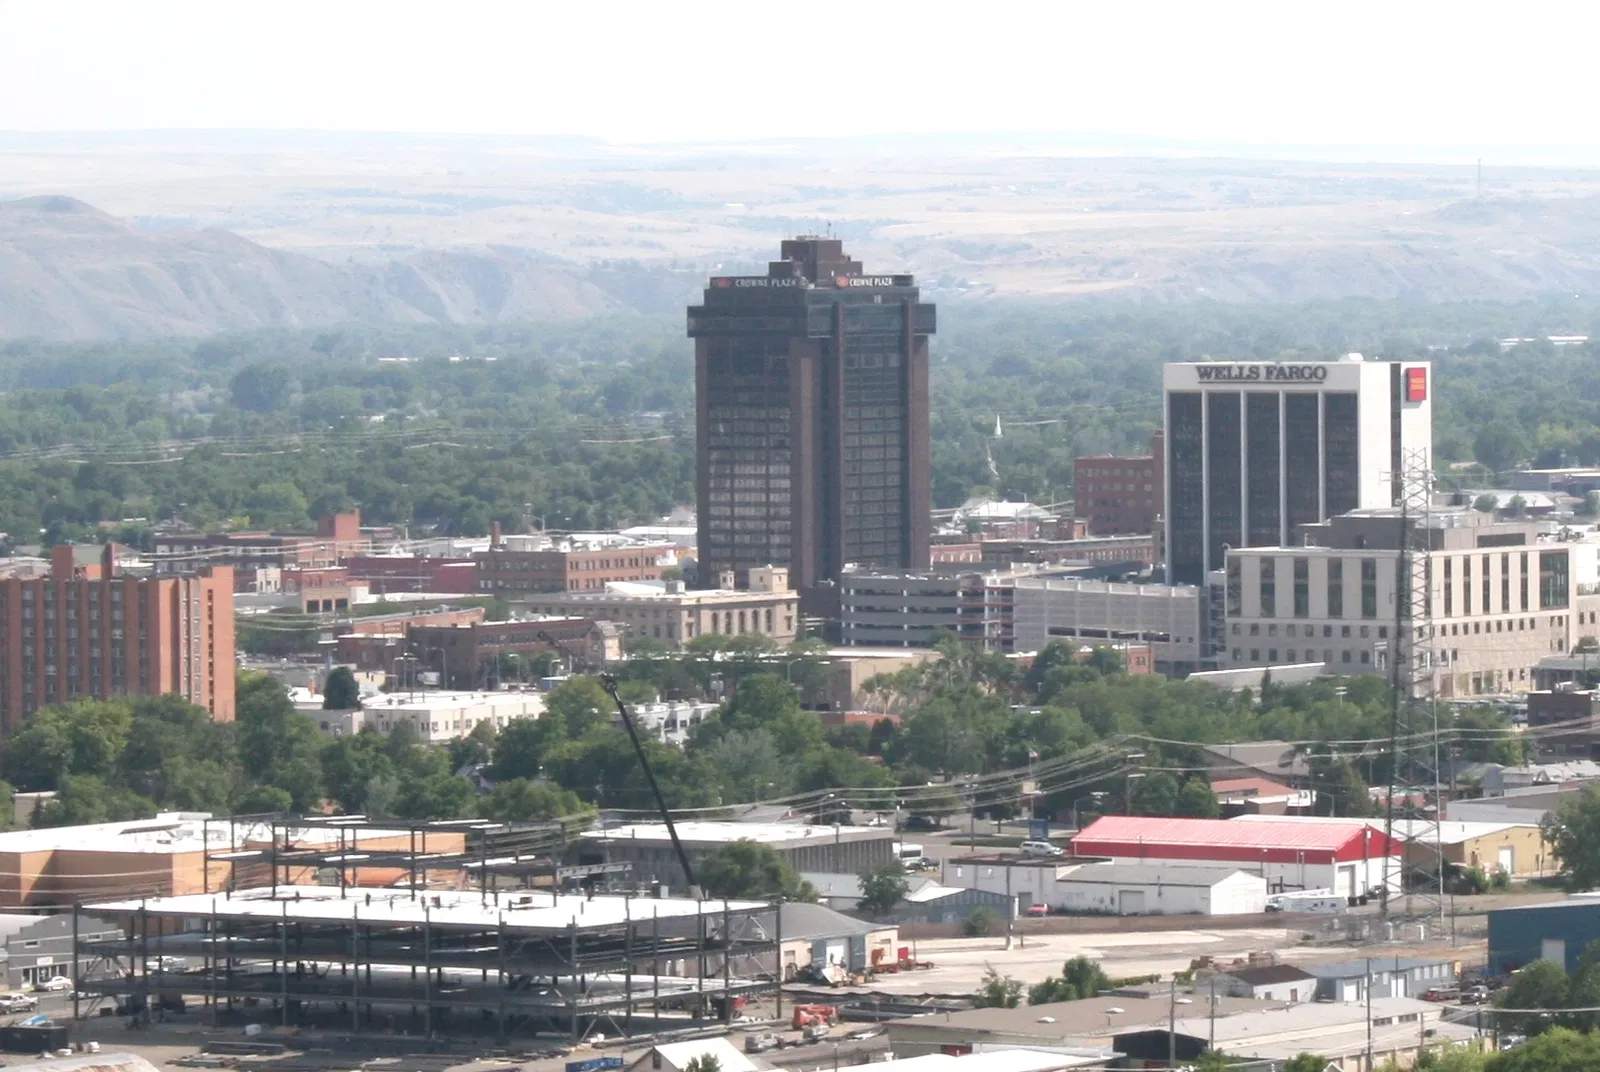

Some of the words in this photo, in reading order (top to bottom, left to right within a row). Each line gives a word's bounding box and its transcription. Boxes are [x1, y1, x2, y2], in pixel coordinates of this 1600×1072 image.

[735, 278, 768, 287] CROWNE
[771, 278, 797, 287] PLAZA
[849, 278, 873, 287] CROWNE
[874, 277, 892, 286] PLAZA
[1195, 365, 1260, 380] WELLS
[1264, 365, 1327, 380] FARGO
